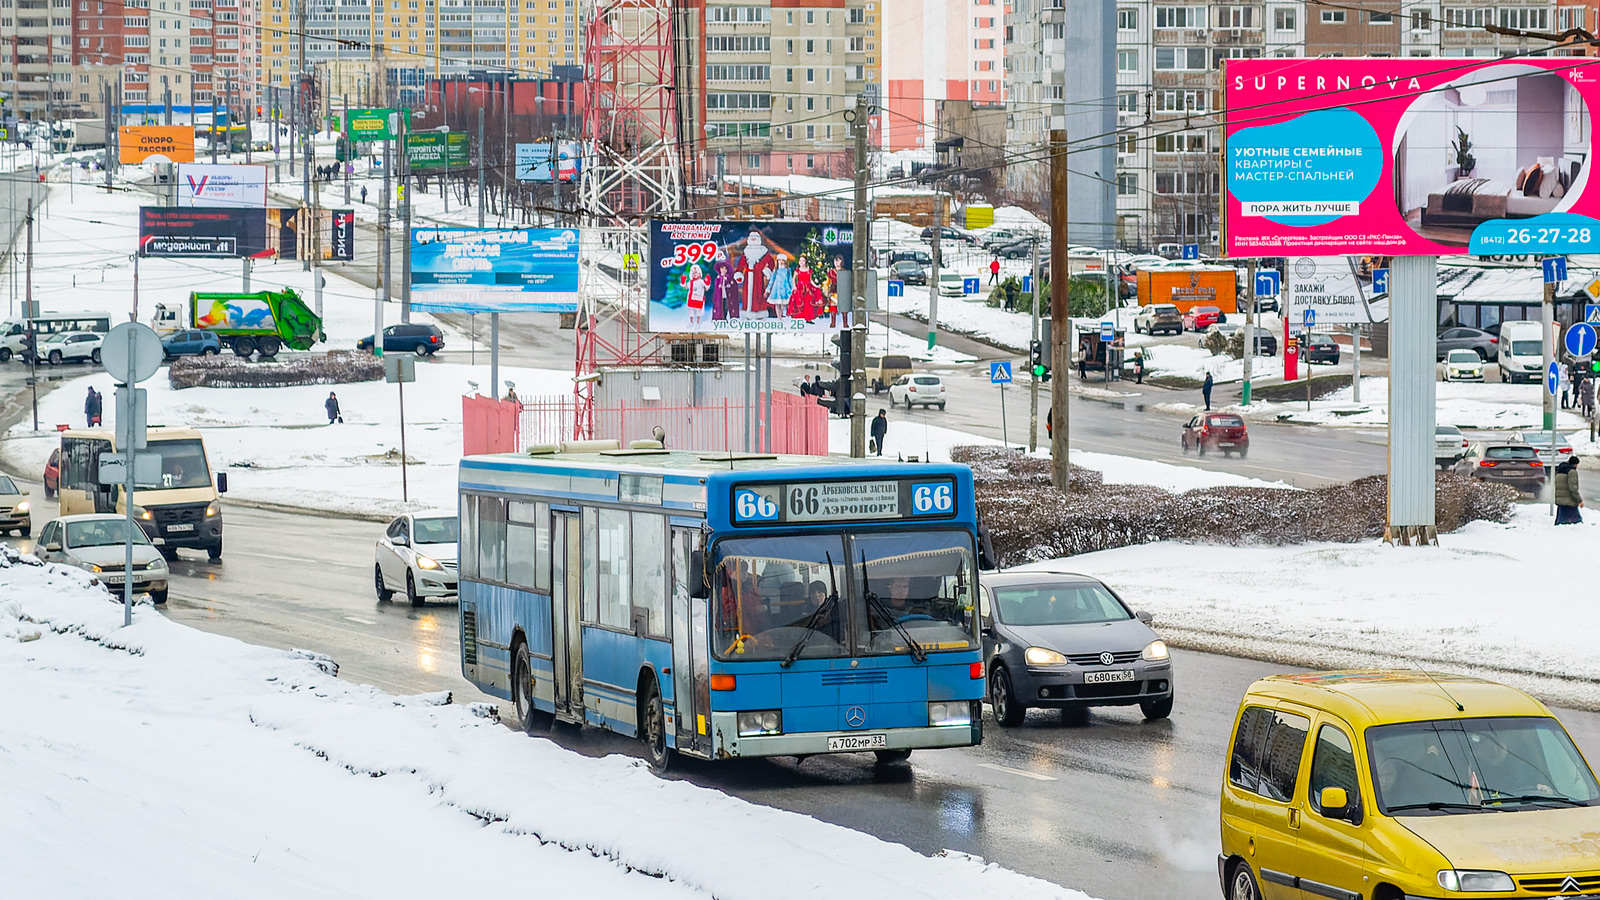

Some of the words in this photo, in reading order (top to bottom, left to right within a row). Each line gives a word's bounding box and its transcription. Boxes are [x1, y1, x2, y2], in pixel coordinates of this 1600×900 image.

[1235, 75, 1420, 90] SUPERNOVA
[1235, 147, 1290, 157] УЮТНЫЕ
[1293, 145, 1363, 156] СЕМЕЙНЫЕ
[1236, 159, 1301, 168] КВАРТИРЫ
[1305, 159, 1312, 168] С
[1235, 170, 1354, 180] МАСТЕР-СПАЛЬНЕЙ
[1251, 204, 1280, 212] ПОРА
[1282, 204, 1312, 212] ЖИТЬ
[1314, 204, 1351, 212] ЛУЧШЕ
[661, 224, 721, 232] КАРНАВАЛЬНЫЕ
[416, 230, 528, 243] ОРТОПЕДИЧЕСКАЯ
[671, 231, 712, 239] КОСТЮМЫ
[1481, 236, 1505, 244] (8412)
[1507, 228, 1591, 243] 26-27-28
[444, 243, 501, 258] ДЕТСКАЯ
[673, 242, 717, 265] 399
[452, 258, 493, 270] ОБУВЬ
[1294, 284, 1325, 293] ЗАКАЖИ
[1294, 295, 1331, 305] ДОСТАВКУ
[1333, 295, 1355, 305] БЛЮД
[790, 319, 805, 329] 2Б
[162, 473, 172, 486] 27
[822, 485, 867, 495] АРБЕКОВСКАЯ
[870, 484, 896, 493] ЗАСТАВА
[790, 487, 819, 515] 66
[915, 485, 951, 511] 66
[738, 493, 776, 518] 66
[822, 503, 897, 515] АЭРОПОРТ
[832, 738, 870, 748] А702МР
